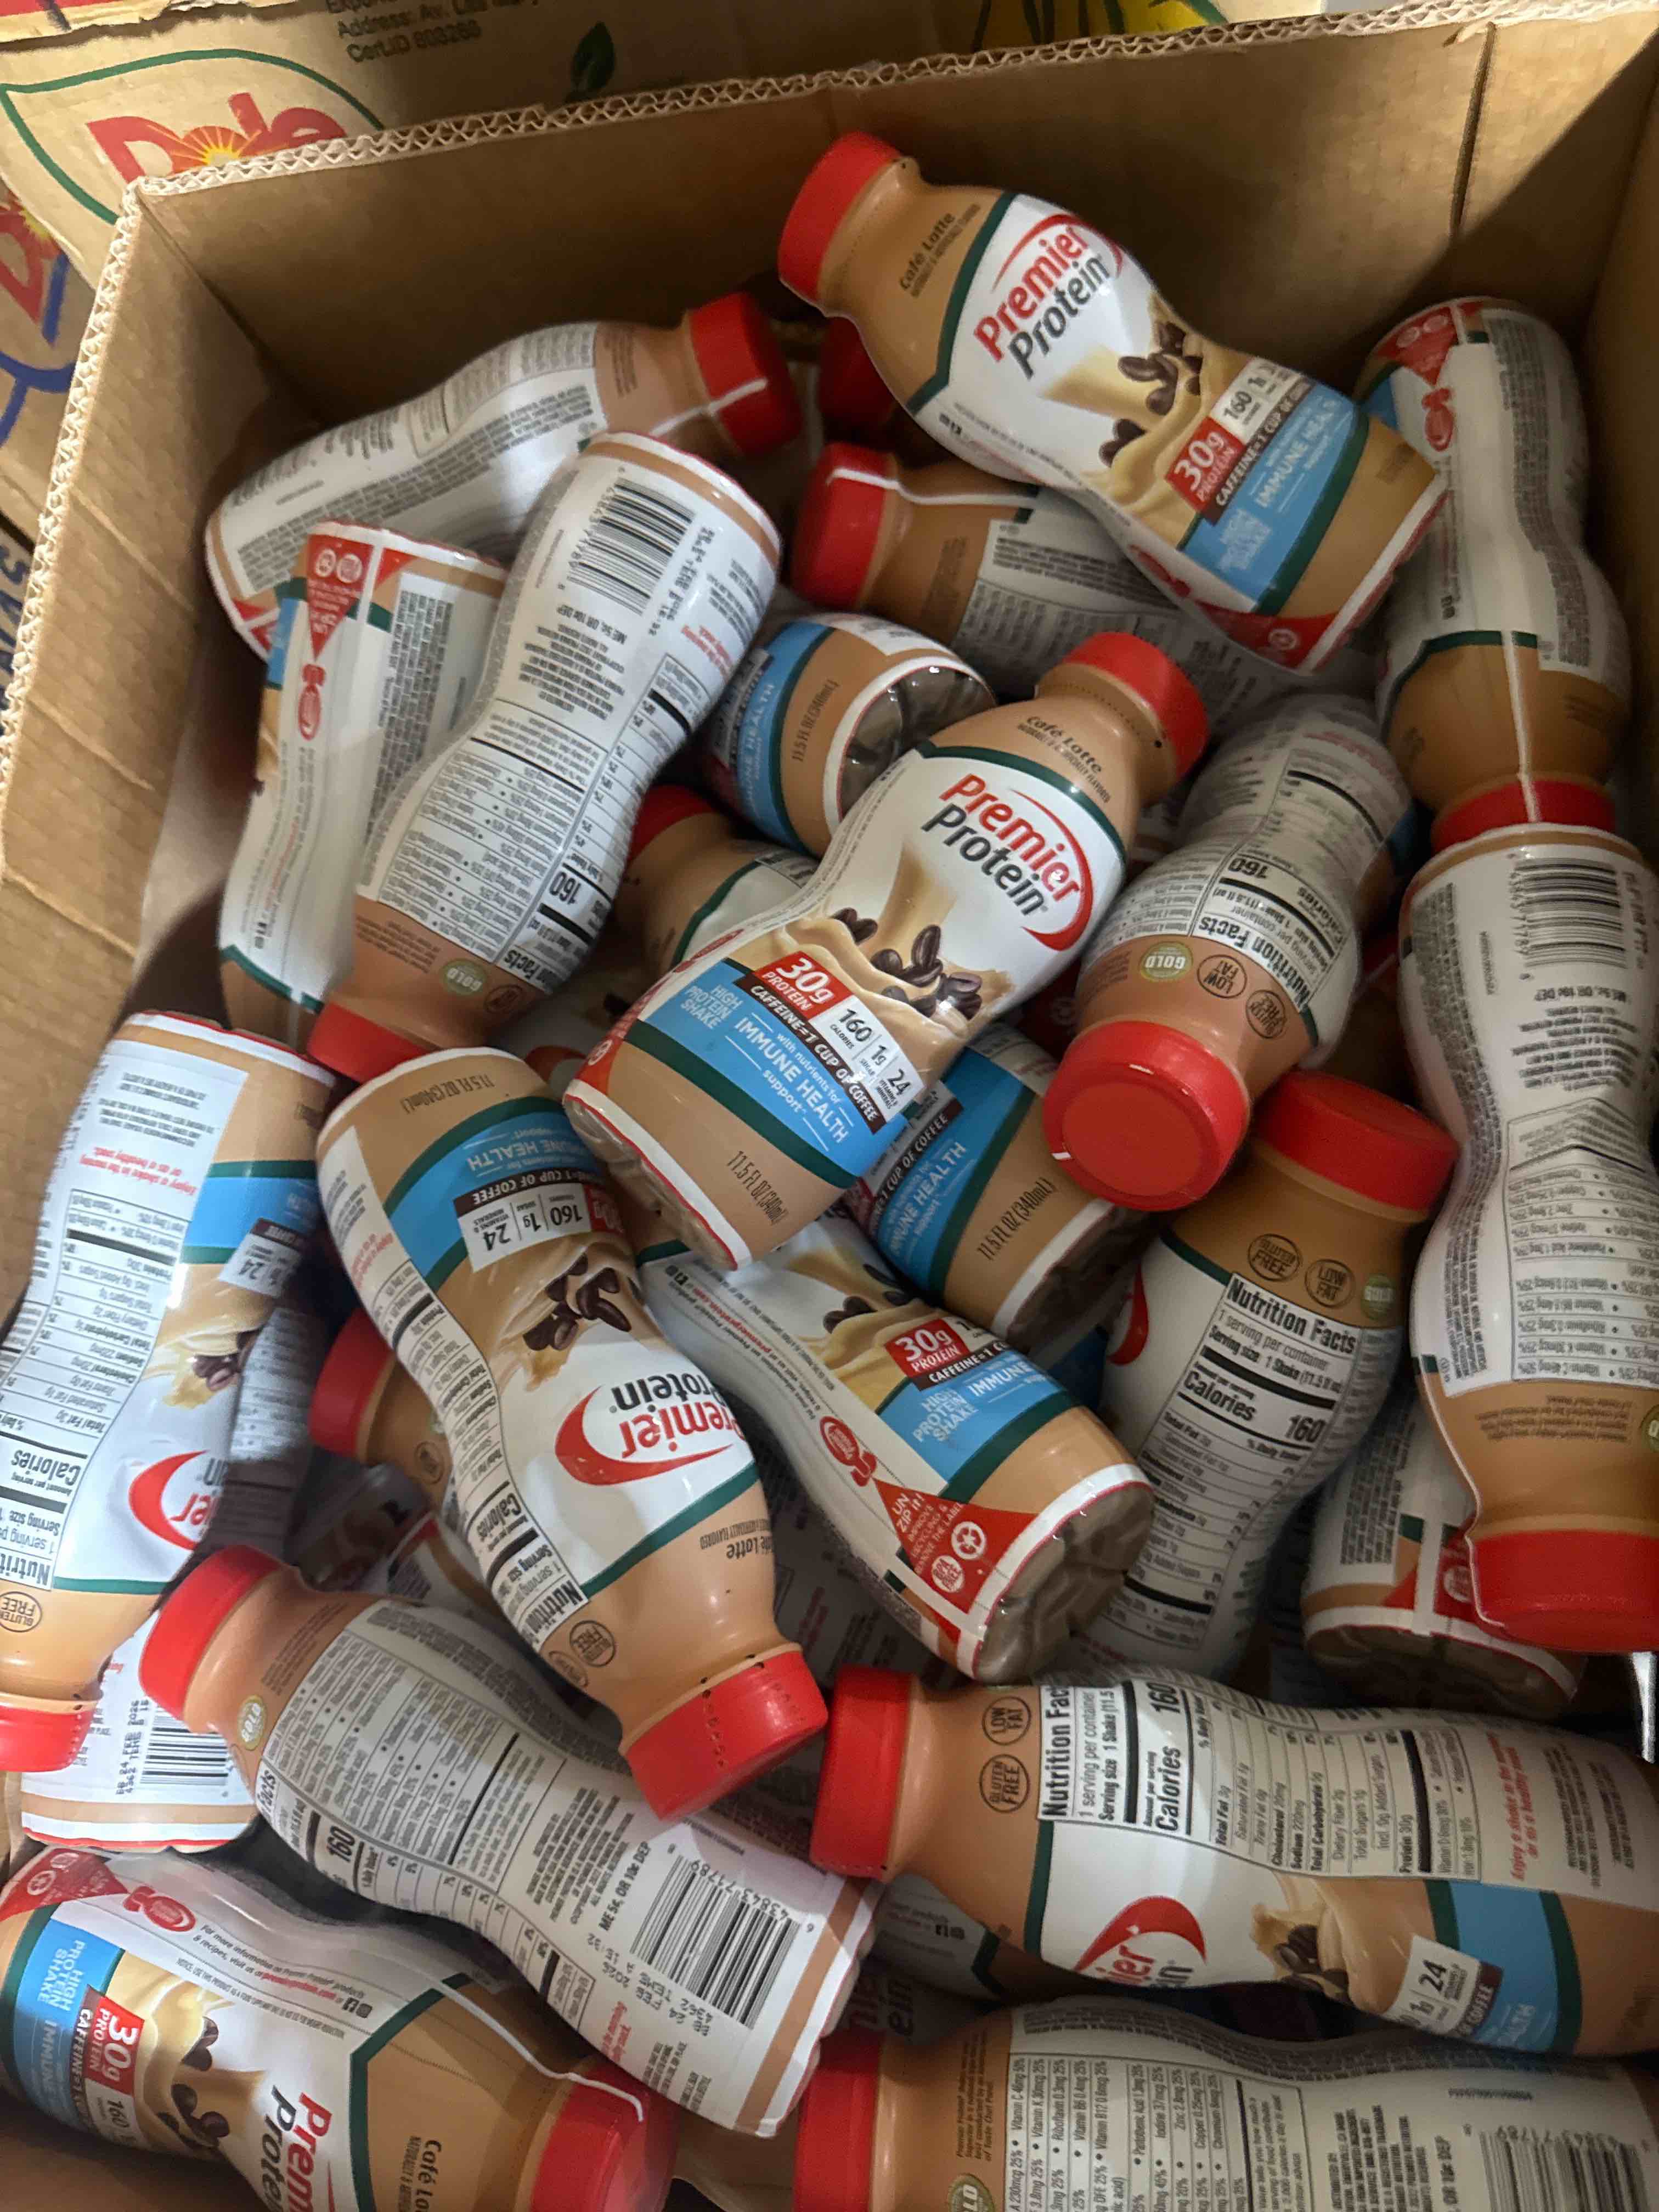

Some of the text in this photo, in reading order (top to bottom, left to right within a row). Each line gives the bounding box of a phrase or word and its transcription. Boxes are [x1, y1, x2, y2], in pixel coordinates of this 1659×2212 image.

[918, 210, 956, 252] Latte
[968, 218, 1091, 362] Premier
[1000, 247, 1115, 380] Protein
[1222, 388, 1254, 423] 160
[1168, 424, 1231, 492] 30g
[1193, 445, 1239, 502] PROTEIN
[1254, 439, 1309, 509] IMMUNE
[555, 603, 574, 618] DEP
[585, 616, 600, 630] OR
[742, 683, 775, 749] HEALTH
[1025, 712, 1105, 776] Café Latte
[938, 764, 1093, 909] Premier
[920, 796, 1055, 922] Protein
[1227, 854, 1271, 881] 160
[549, 869, 582, 906] 160
[446, 966, 483, 992] GOLD
[503, 945, 540, 981] Facts
[774, 947, 841, 1010] 30g
[1144, 953, 1186, 970] GOLD
[1197, 913, 1311, 1008] Nutrition Facts
[1214, 958, 1238, 979] FAT
[710, 983, 742, 1012] HIGH
[761, 968, 814, 1013] PROTEIN
[1203, 970, 1234, 994] LOW
[680, 996, 721, 1031] SHAKE
[685, 983, 732, 1020] PROTEIN
[828, 1023, 855, 1051] CALORIES
[837, 1005, 874, 1045] 160
[775, 1030, 842, 1106] with nutrients for
[871, 1043, 889, 1069] 1g
[733, 1015, 850, 1144] IMMUNE HEALTH
[813, 1041, 879, 1124] CUP COFFEE
[885, 1065, 912, 1097] 24
[466, 1139, 538, 1172] HEALTH
[884, 1111, 950, 1191] CUP OF COFFEE
[170, 1178, 196, 1197] Enjoy
[471, 1169, 562, 1204] CUP OF COFFEE
[911, 1141, 967, 1205] HEALTH
[549, 1203, 583, 1227] 160
[482, 1222, 510, 1252] 24
[236, 1258, 265, 1281] 24
[1251, 1249, 1288, 1278] FREE
[1226, 1278, 1358, 1356] Nutrition Facts
[132, 1336, 150, 1351] Total
[894, 1318, 953, 1364] 30g
[911, 1342, 960, 1375] PROTEIN
[1208, 1323, 1300, 1381] Serving size Shake
[1225, 1313, 1328, 1371] serving per container
[967, 1356, 1035, 1398] IMMUNE
[921, 1386, 956, 1412] HIGH
[1182, 1369, 1325, 1445] Calories 160
[68, 1413, 105, 1433] Total Fat
[9, 1448, 80, 1487] Calories
[472, 1493, 523, 1543] Calories
[891, 1492, 910, 1517] UN
[895, 1506, 914, 1532] ZIP
[8, 1510, 60, 1537] Serving size
[10, 1528, 47, 1552] serving
[517, 1543, 552, 1573] Serving
[726, 1538, 758, 1560] Latte
[517, 1564, 554, 1597] serving
[575, 1627, 602, 1653] FREE
[238, 1701, 263, 1742] GOLD
[990, 1706, 1005, 1736] LOW
[1007, 1707, 1023, 1730] FAT
[1077, 1690, 1097, 1807] serving per container
[1097, 1713, 1117, 1821] Serving size Shake
[1148, 1682, 1183, 1831] Calories 160
[1000, 1764, 1021, 1805] FREE
[1041, 1722, 1073, 1818] Nutrition
[1214, 1800, 1229, 1846] Total Fat
[1270, 1809, 1286, 1866] Cholesterol
[324, 1825, 358, 1863] 160
[1310, 1845, 1323, 1872] Total
[597, 1911, 615, 1931] ME
[615, 1880, 631, 1898] OR
[632, 1840, 652, 1864] DEP
[689, 1858, 737, 1893] 71789
[740, 1886, 790, 1922] 43843
[200, 1923, 234, 1949] For more
[805, 1922, 815, 1933] 6
[199, 1938, 246, 1970] recipes, visit
[37, 1948, 68, 2003] SHAKE
[49, 1940, 84, 2007] PROTEIN
[60, 1970, 83, 2011] HIGH
[1418, 1959, 1447, 1991] 24
[665, 2006, 687, 2025] 24
[1466, 1983, 1493, 2025] COFFEE
[88, 2008, 111, 2070] PROTEIN
[98, 2016, 140, 2083] 30g
[1011, 2102, 1023, 2130] Vitamin
[280, 2091, 335, 2212] Prem
[1030, 2108, 1043, 2176] 25% Vitamin
[417, 2138, 442, 2185] Café
[1051, 2169, 1063, 2188] 25%
